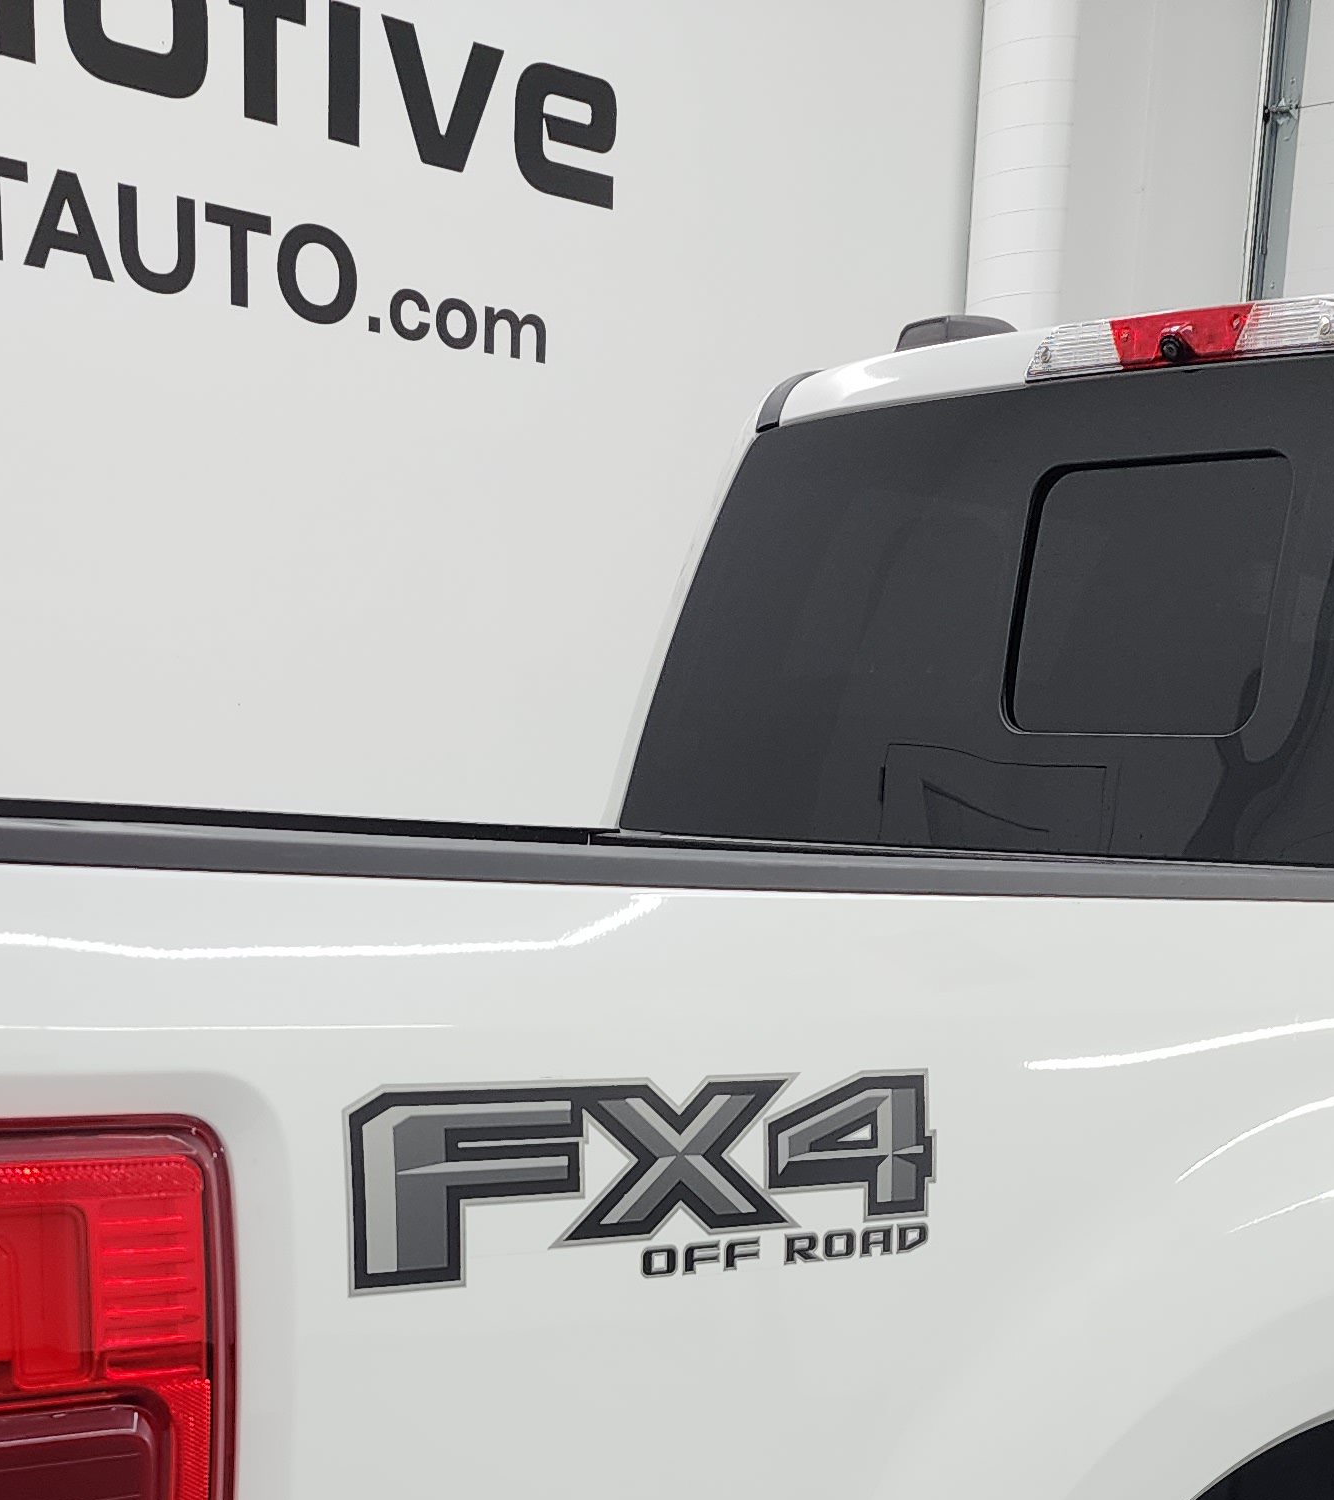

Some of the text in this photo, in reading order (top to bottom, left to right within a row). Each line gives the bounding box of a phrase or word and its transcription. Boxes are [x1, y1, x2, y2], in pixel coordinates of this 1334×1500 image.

[342, 1068, 937, 1298] FX4
[640, 1221, 929, 1279] OFF ROAD
